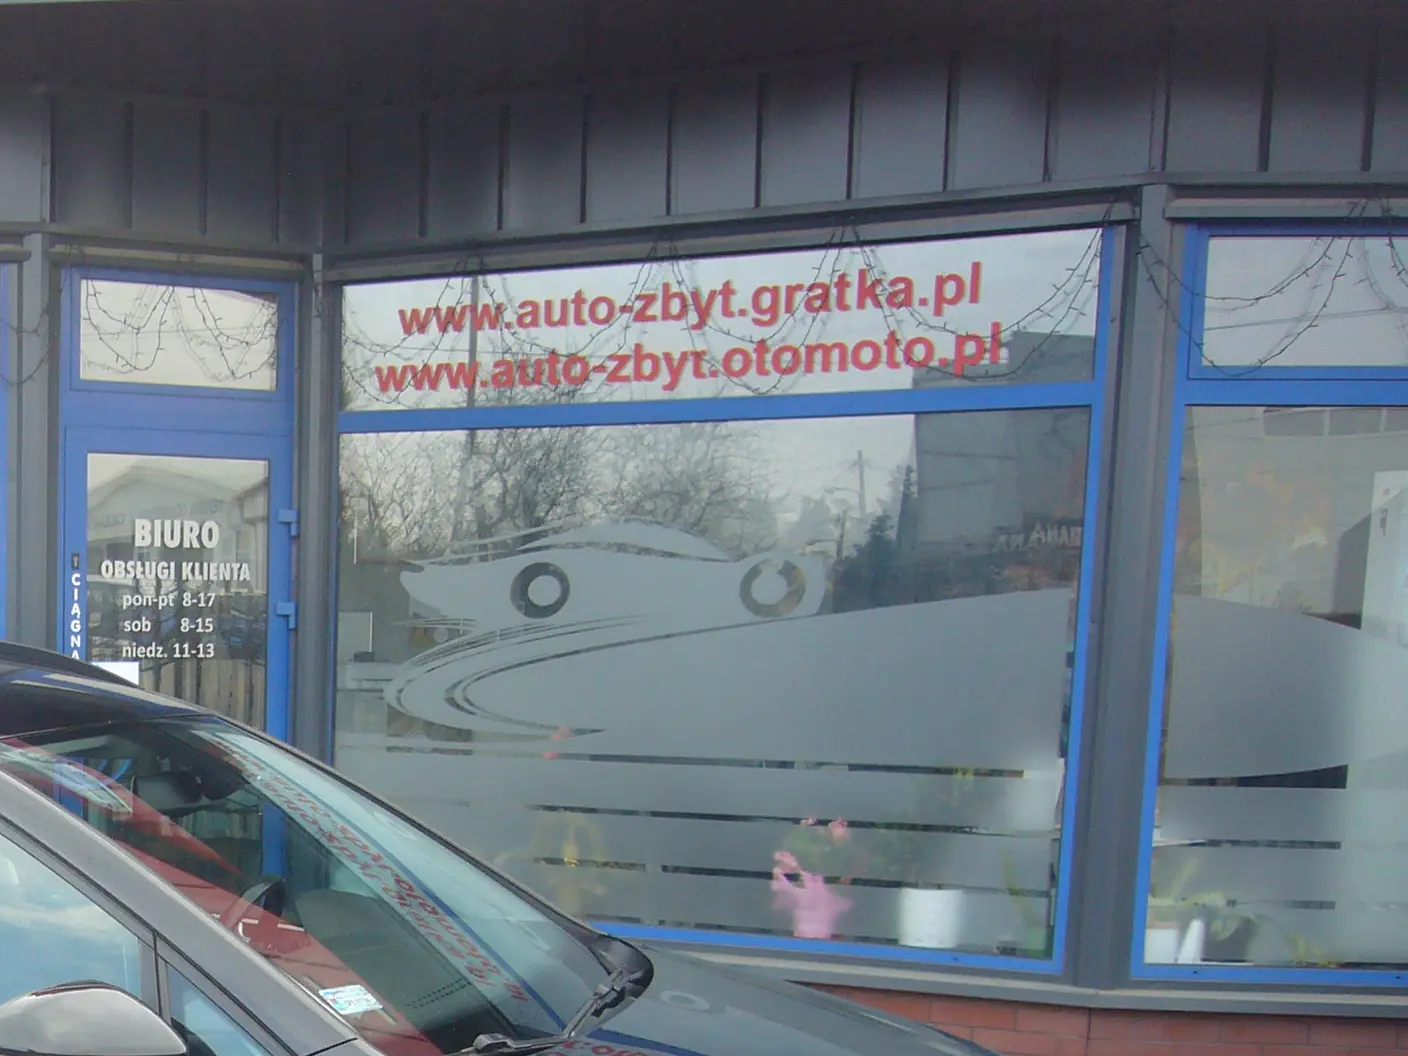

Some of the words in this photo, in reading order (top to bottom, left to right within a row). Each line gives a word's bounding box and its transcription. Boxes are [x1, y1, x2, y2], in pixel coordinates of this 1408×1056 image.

[398, 261, 982, 336] www.auto-zbyt.gratka.pl
[375, 322, 1001, 393] www.auto-zbyt.otomoto.pl
[134, 518, 220, 549] BIURO
[100, 560, 176, 580] OBSŁUGI
[181, 561, 251, 581] KLIENTA
[122, 593, 175, 610] pon-pt
[182, 592, 215, 608] 8-17
[123, 617, 152, 633] sob
[180, 617, 214, 633] 8-15
[122, 642, 168, 658] niedz.
[173, 643, 215, 658] 11-13
